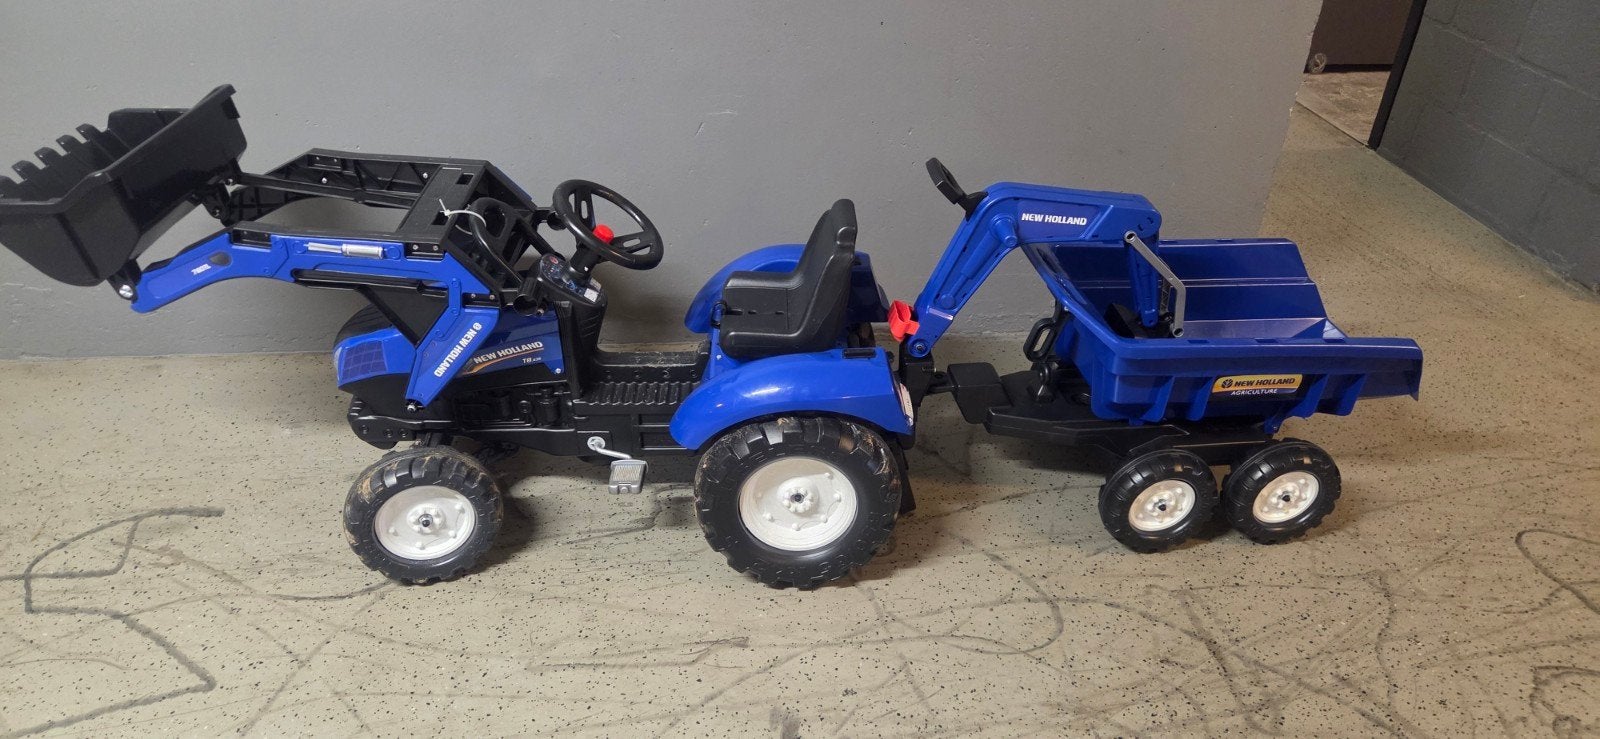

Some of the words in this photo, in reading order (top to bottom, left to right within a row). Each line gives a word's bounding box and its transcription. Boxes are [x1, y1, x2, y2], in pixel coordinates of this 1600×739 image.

[1021, 213, 1044, 222] NEW
[1044, 214, 1087, 226] HOLLAND
[459, 328, 478, 348] NEW
[473, 353, 497, 364] NEW
[497, 341, 543, 357] HOLLAND
[433, 346, 464, 377] HOLLAND
[1255, 378, 1296, 386] HOLLAND
[1230, 388, 1278, 396] AGRICULTURE
